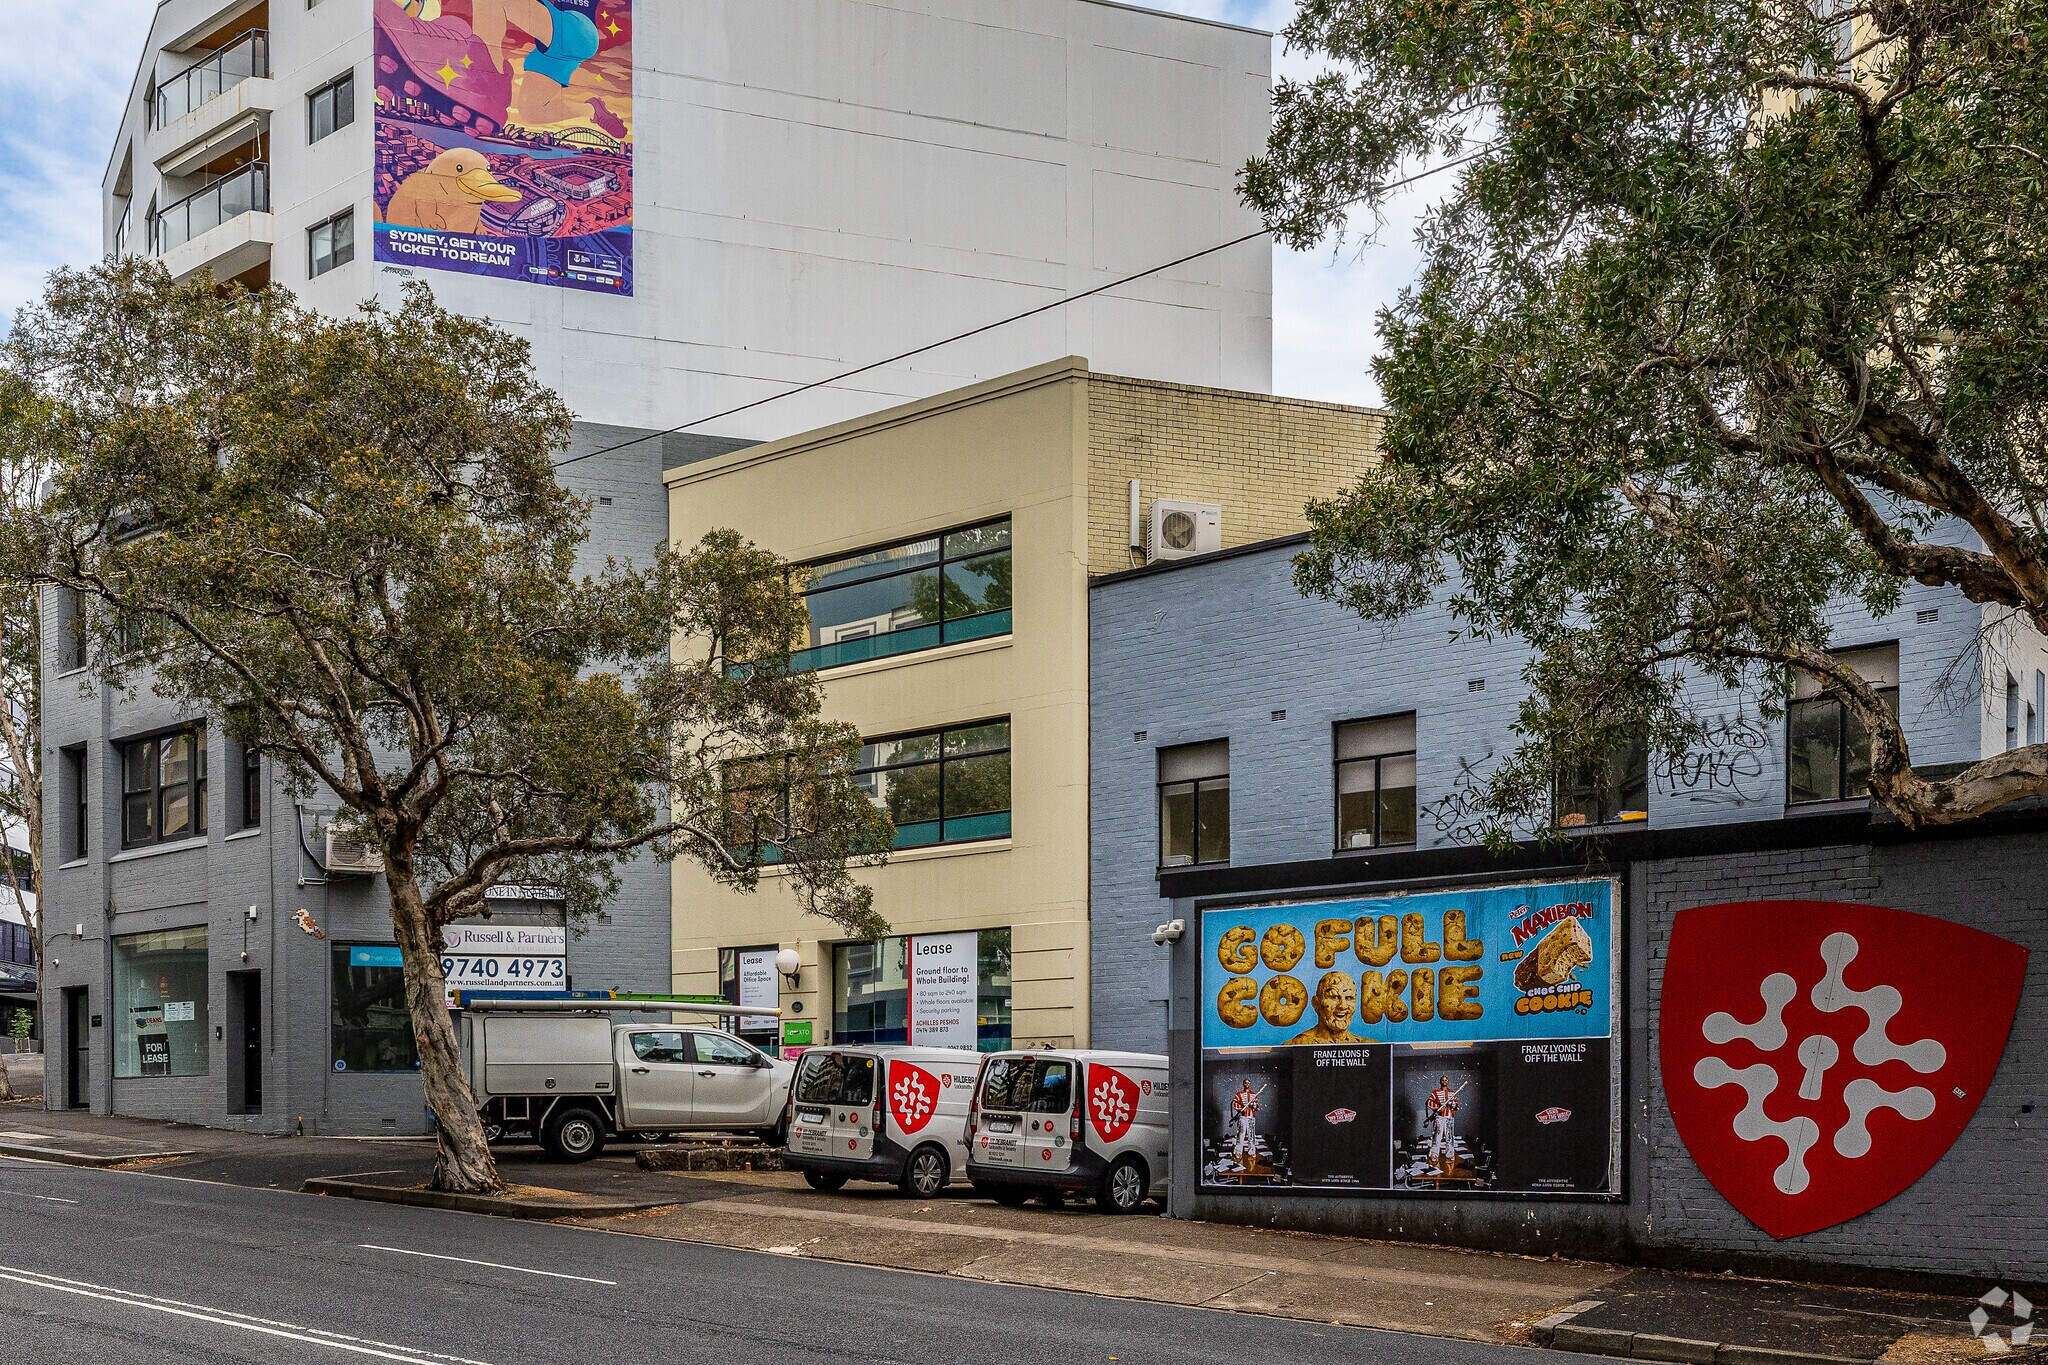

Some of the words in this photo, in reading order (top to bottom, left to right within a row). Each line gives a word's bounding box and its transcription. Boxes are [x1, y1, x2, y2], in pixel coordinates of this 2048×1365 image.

[389, 230, 448, 248] SYDNEY,
[449, 238, 476, 250] GET
[478, 240, 516, 256] YOUR
[390, 242, 438, 256] TICKET
[440, 248, 459, 260] TO
[460, 252, 510, 266] DREAM
[1510, 902, 1593, 948] MAXIBON
[464, 930, 504, 943] Russell
[506, 931, 514, 943] &
[518, 931, 564, 944] Partners
[1218, 923, 1306, 974] GO
[1314, 910, 1484, 969] FULL
[916, 942, 952, 956] Lease
[744, 956, 762, 964] Lease
[442, 958, 498, 978] 9740
[508, 958, 564, 978] 4973
[916, 967, 941, 976] Ground
[942, 966, 959, 974] floor
[916, 976, 936, 985] Whole
[938, 975, 970, 985] Building!
[1218, 965, 1484, 1028] COKIE
[1527, 986, 1555, 997] CHOC
[1556, 984, 1581, 994] CHIP
[1516, 990, 1593, 1014] COOKIE
[146, 1043, 163, 1053] FOR
[1338, 1050, 1361, 1058] LYONS
[1522, 1045, 1548, 1054] FRANZ
[1550, 1044, 1576, 1053] LYONS
[1578, 1044, 1586, 1052] IS
[142, 1054, 169, 1064] LEASE
[1542, 1054, 1558, 1062] THE
[1560, 1053, 1582, 1062] WALL
